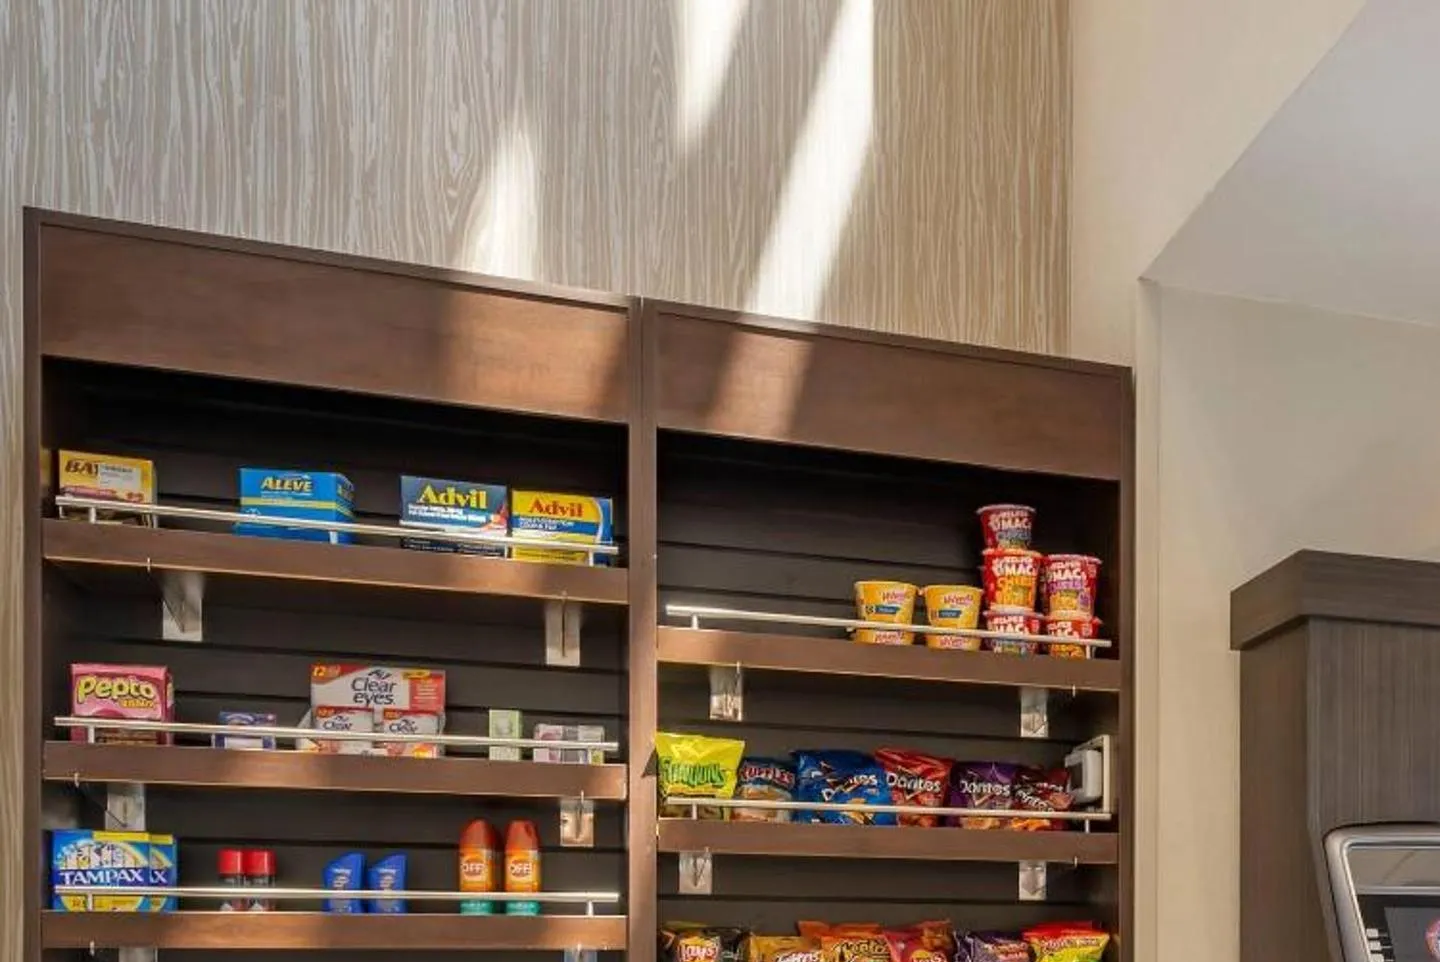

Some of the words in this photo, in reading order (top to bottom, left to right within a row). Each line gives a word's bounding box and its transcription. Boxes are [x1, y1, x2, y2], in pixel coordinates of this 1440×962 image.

[416, 484, 487, 509] Advil
[528, 498, 583, 517] Advil
[77, 675, 155, 704] Pepto
[351, 677, 397, 694] Clear
[353, 692, 396, 708] eyes
[886, 772, 942, 794] Doritos
[59, 869, 145, 886] TAMPAX
